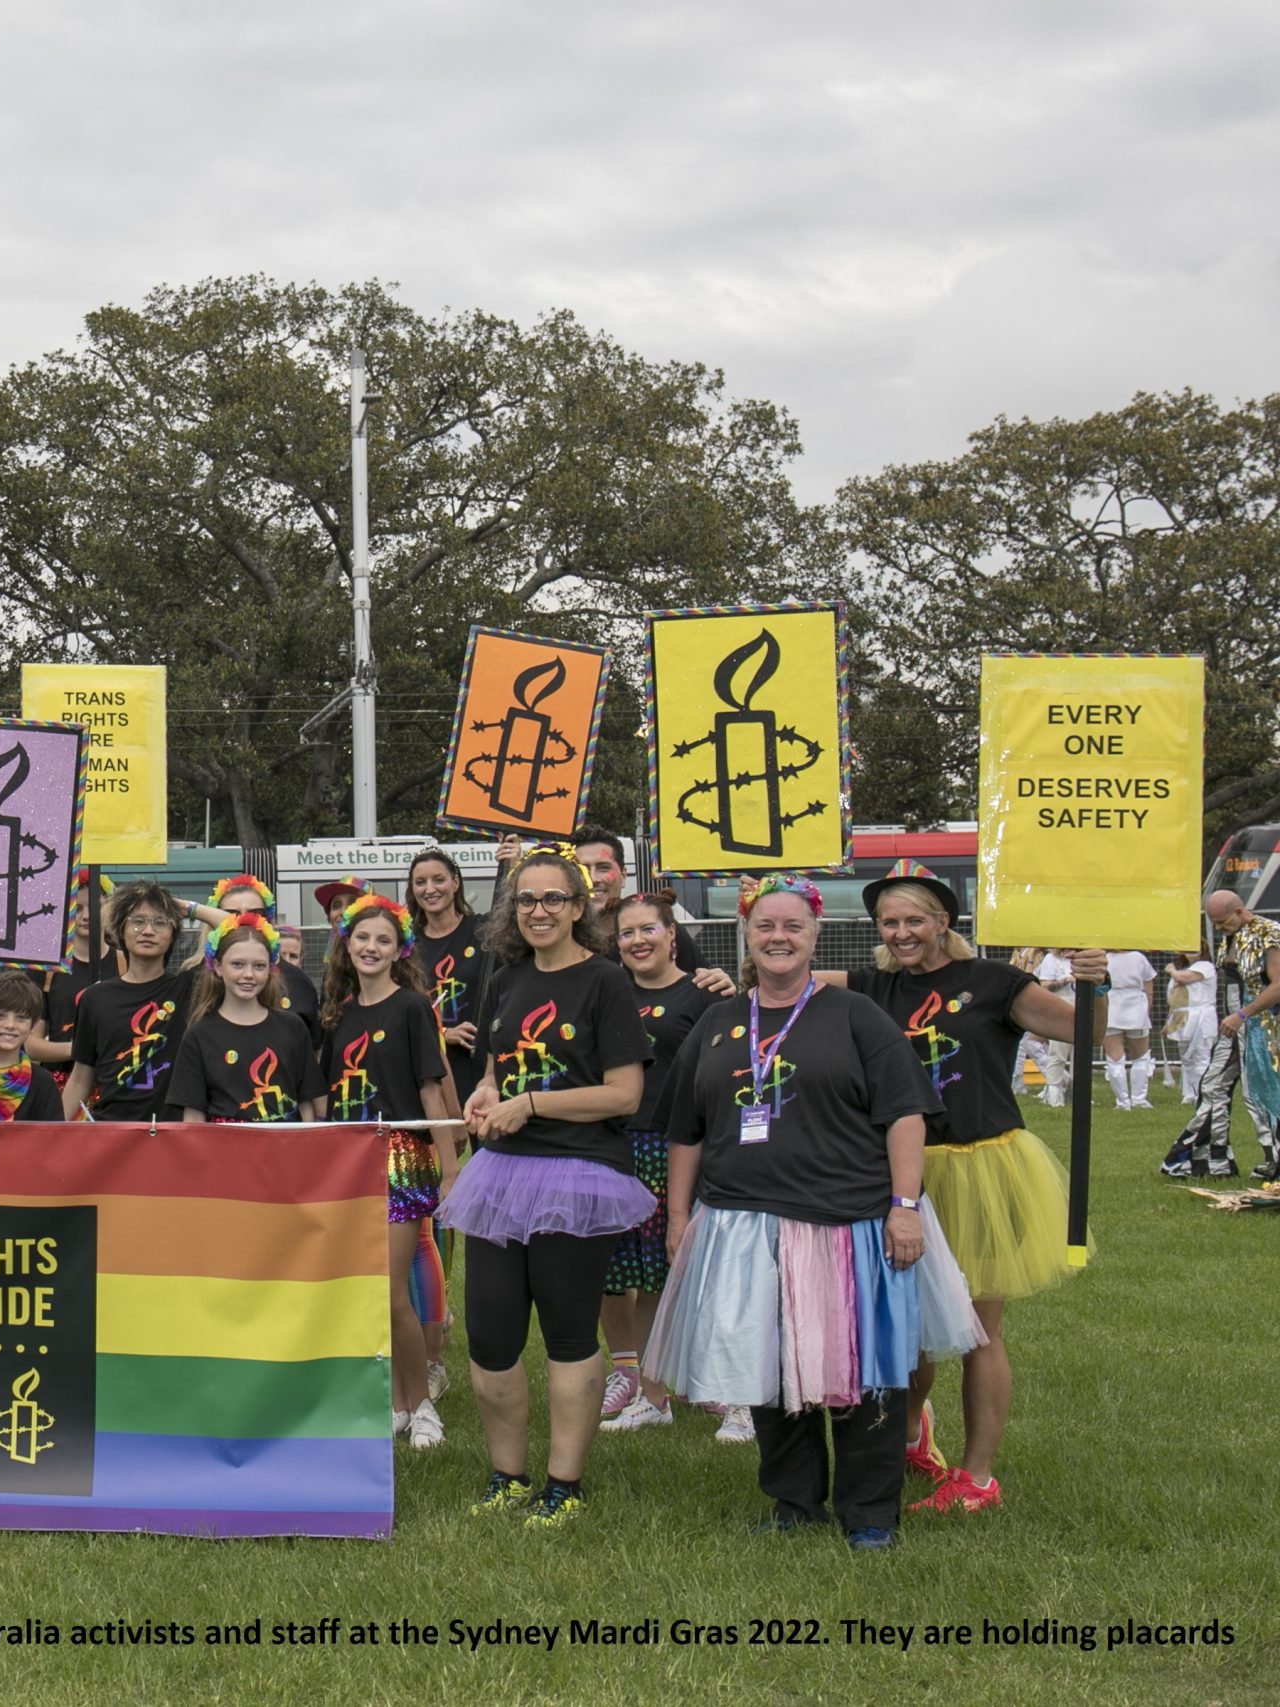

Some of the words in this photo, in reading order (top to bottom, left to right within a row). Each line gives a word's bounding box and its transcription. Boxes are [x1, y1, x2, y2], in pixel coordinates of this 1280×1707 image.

[63, 691, 126, 706] TRANS
[61, 712, 129, 727] RIGHTS
[1047, 704, 1142, 725] EVERY
[89, 733, 114, 747] RE
[1064, 735, 1124, 755] ONE
[88, 758, 129, 772] MAN
[85, 778, 130, 793] GHTS
[1017, 777, 1171, 799] DESERVES
[1038, 807, 1149, 829] SAFETY
[297, 850, 344, 865] Meet
[348, 849, 378, 864] the
[383, 848, 414, 864] bra
